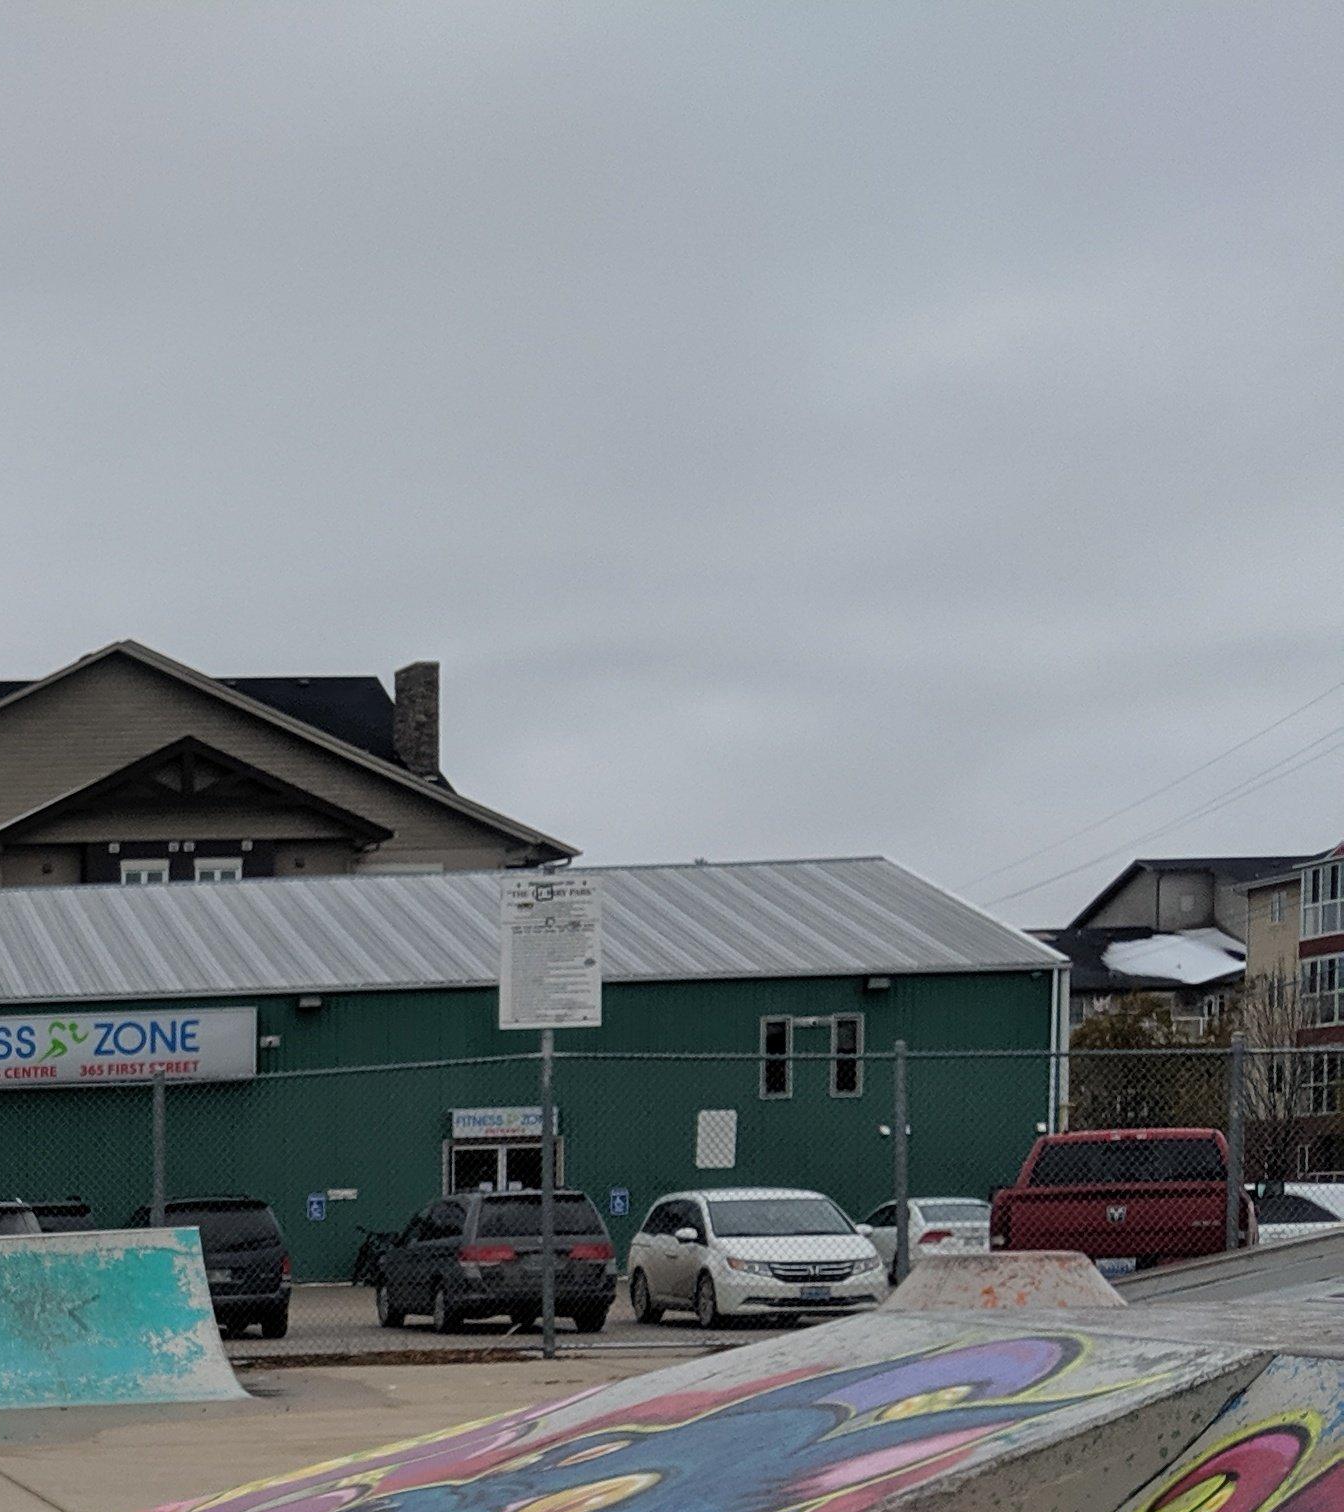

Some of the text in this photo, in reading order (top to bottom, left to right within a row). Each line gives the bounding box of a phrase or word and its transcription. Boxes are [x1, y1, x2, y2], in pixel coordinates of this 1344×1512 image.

[93, 1019, 201, 1056] ZONE
[4, 1065, 58, 1079] CENTRE
[80, 1064, 104, 1077] 365
[107, 1062, 145, 1076] FIRST
